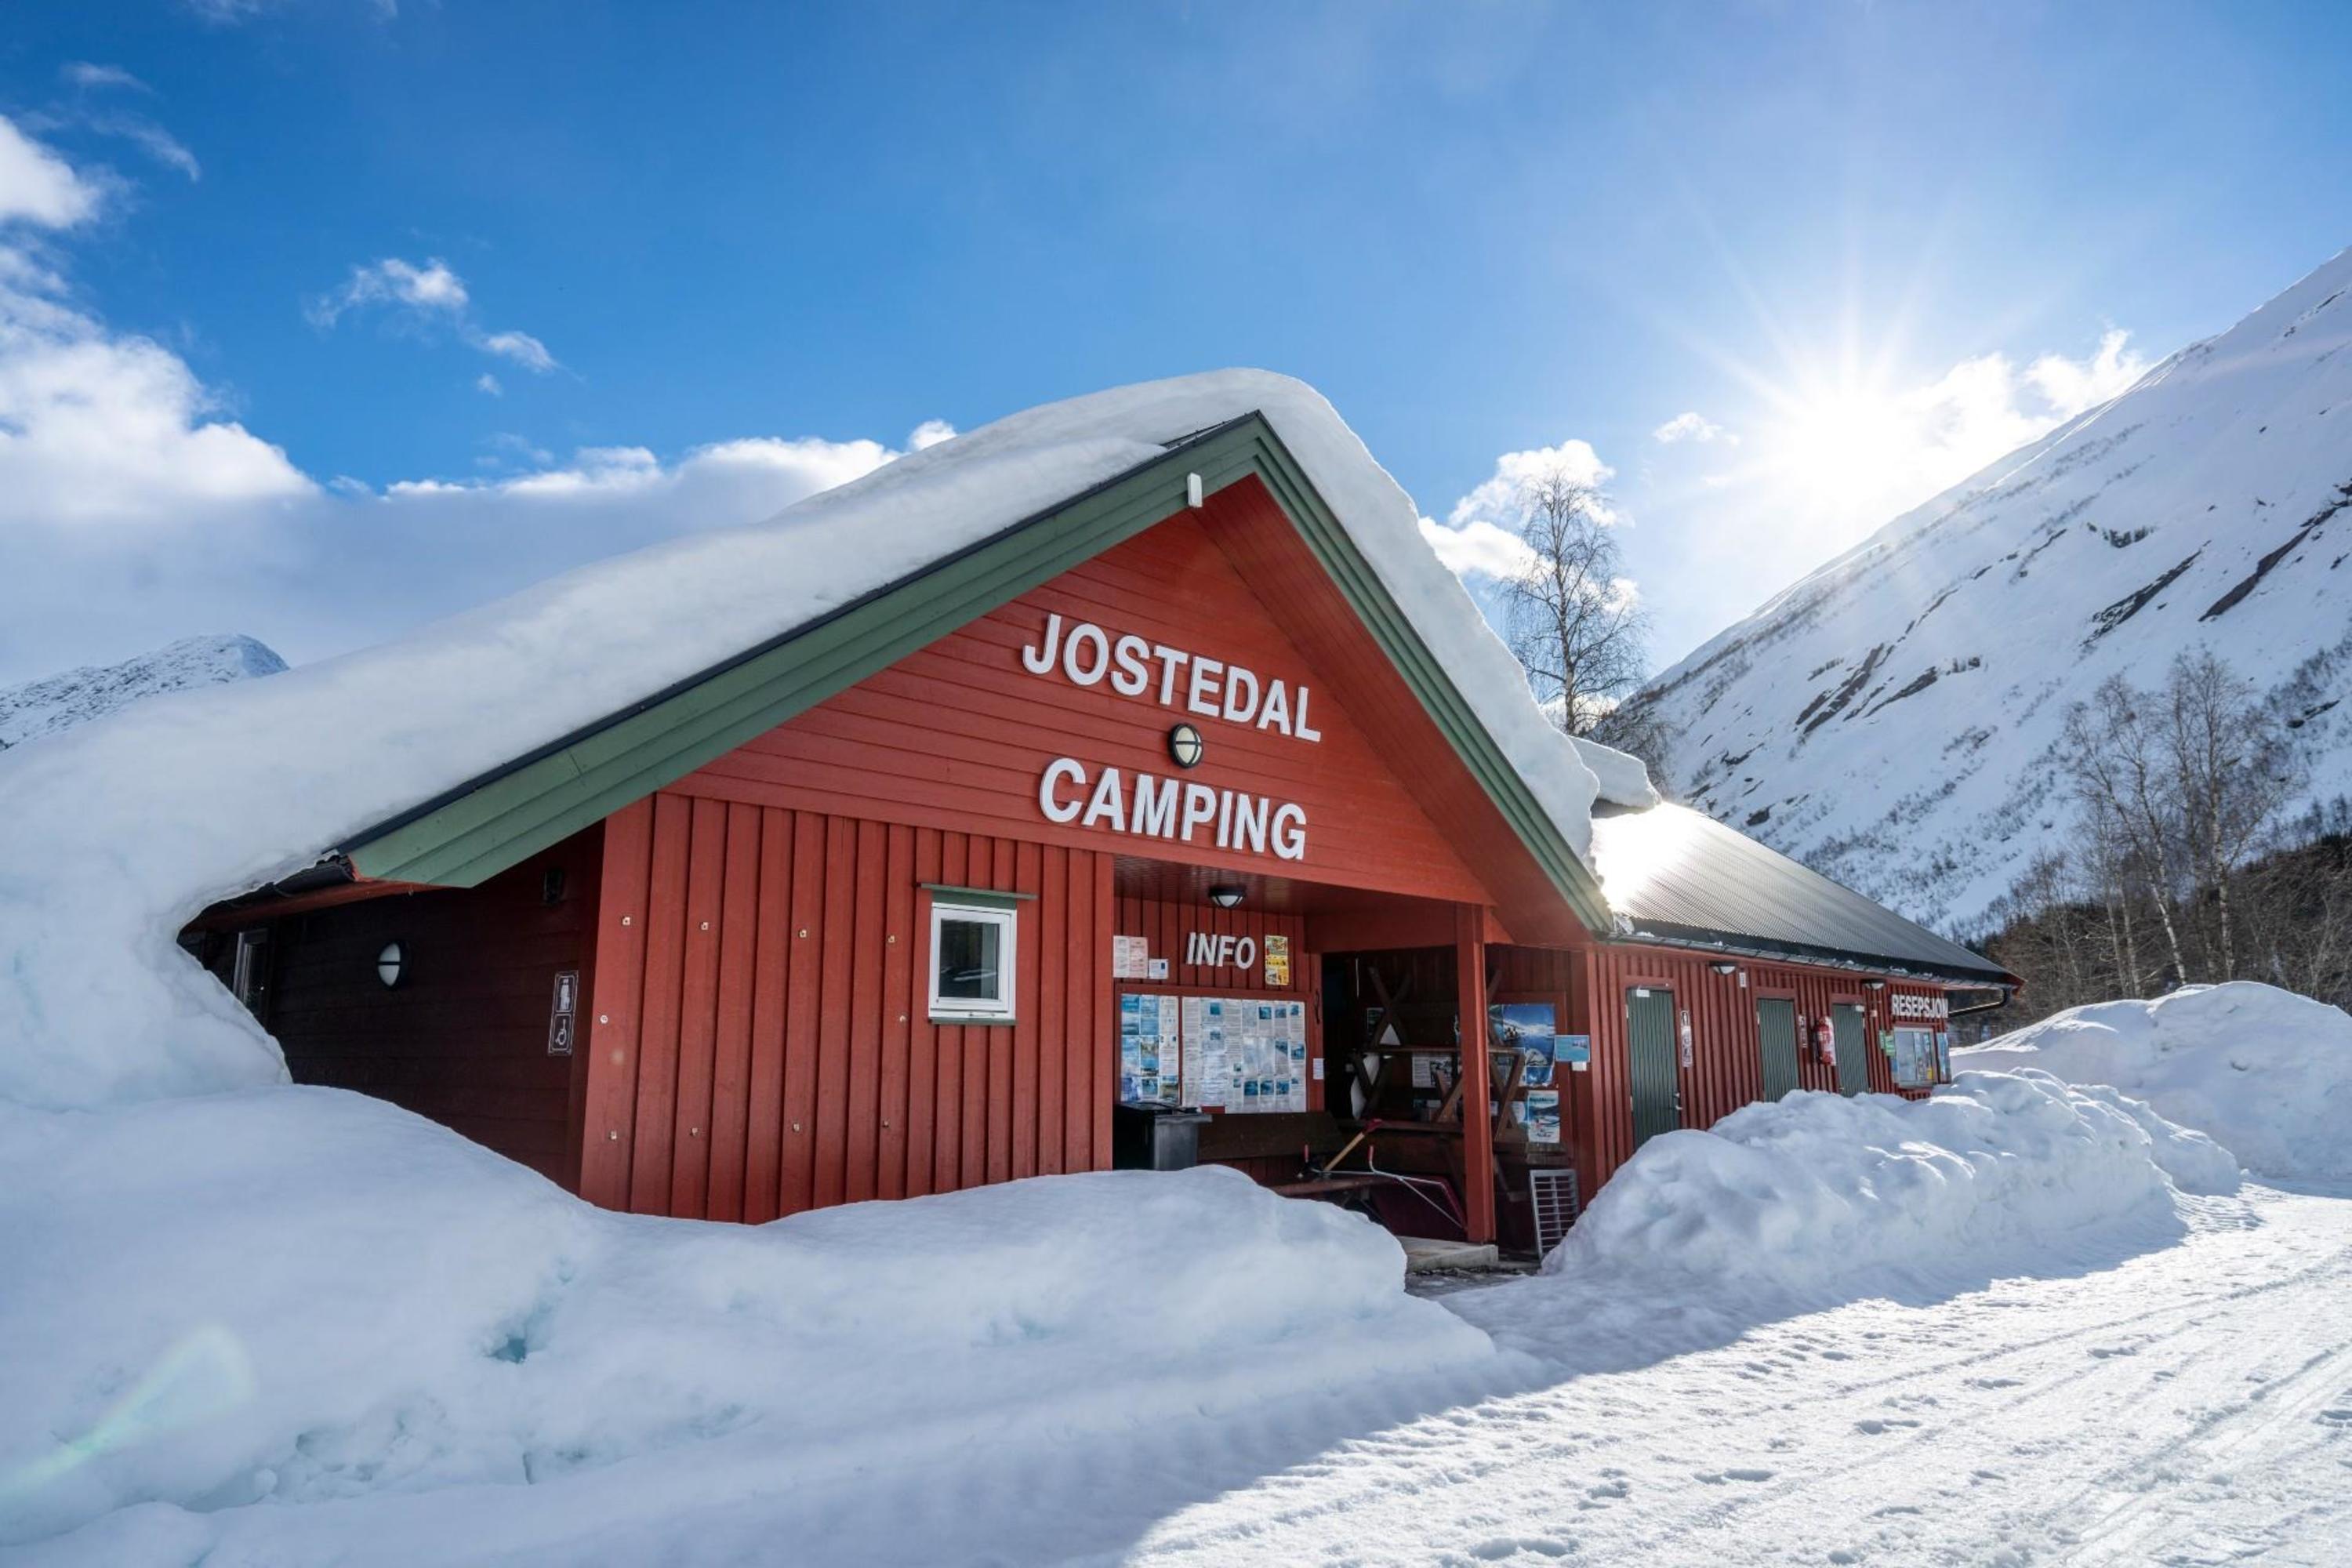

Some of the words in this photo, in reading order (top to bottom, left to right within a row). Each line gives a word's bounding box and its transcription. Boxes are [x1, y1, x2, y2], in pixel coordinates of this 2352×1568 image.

[1022, 614, 1322, 742] JOSTEDAL
[1039, 757, 1307, 860] CAMPING
[1185, 931, 1256, 970] INFO
[1891, 994, 1949, 1018] RESEPSJON
